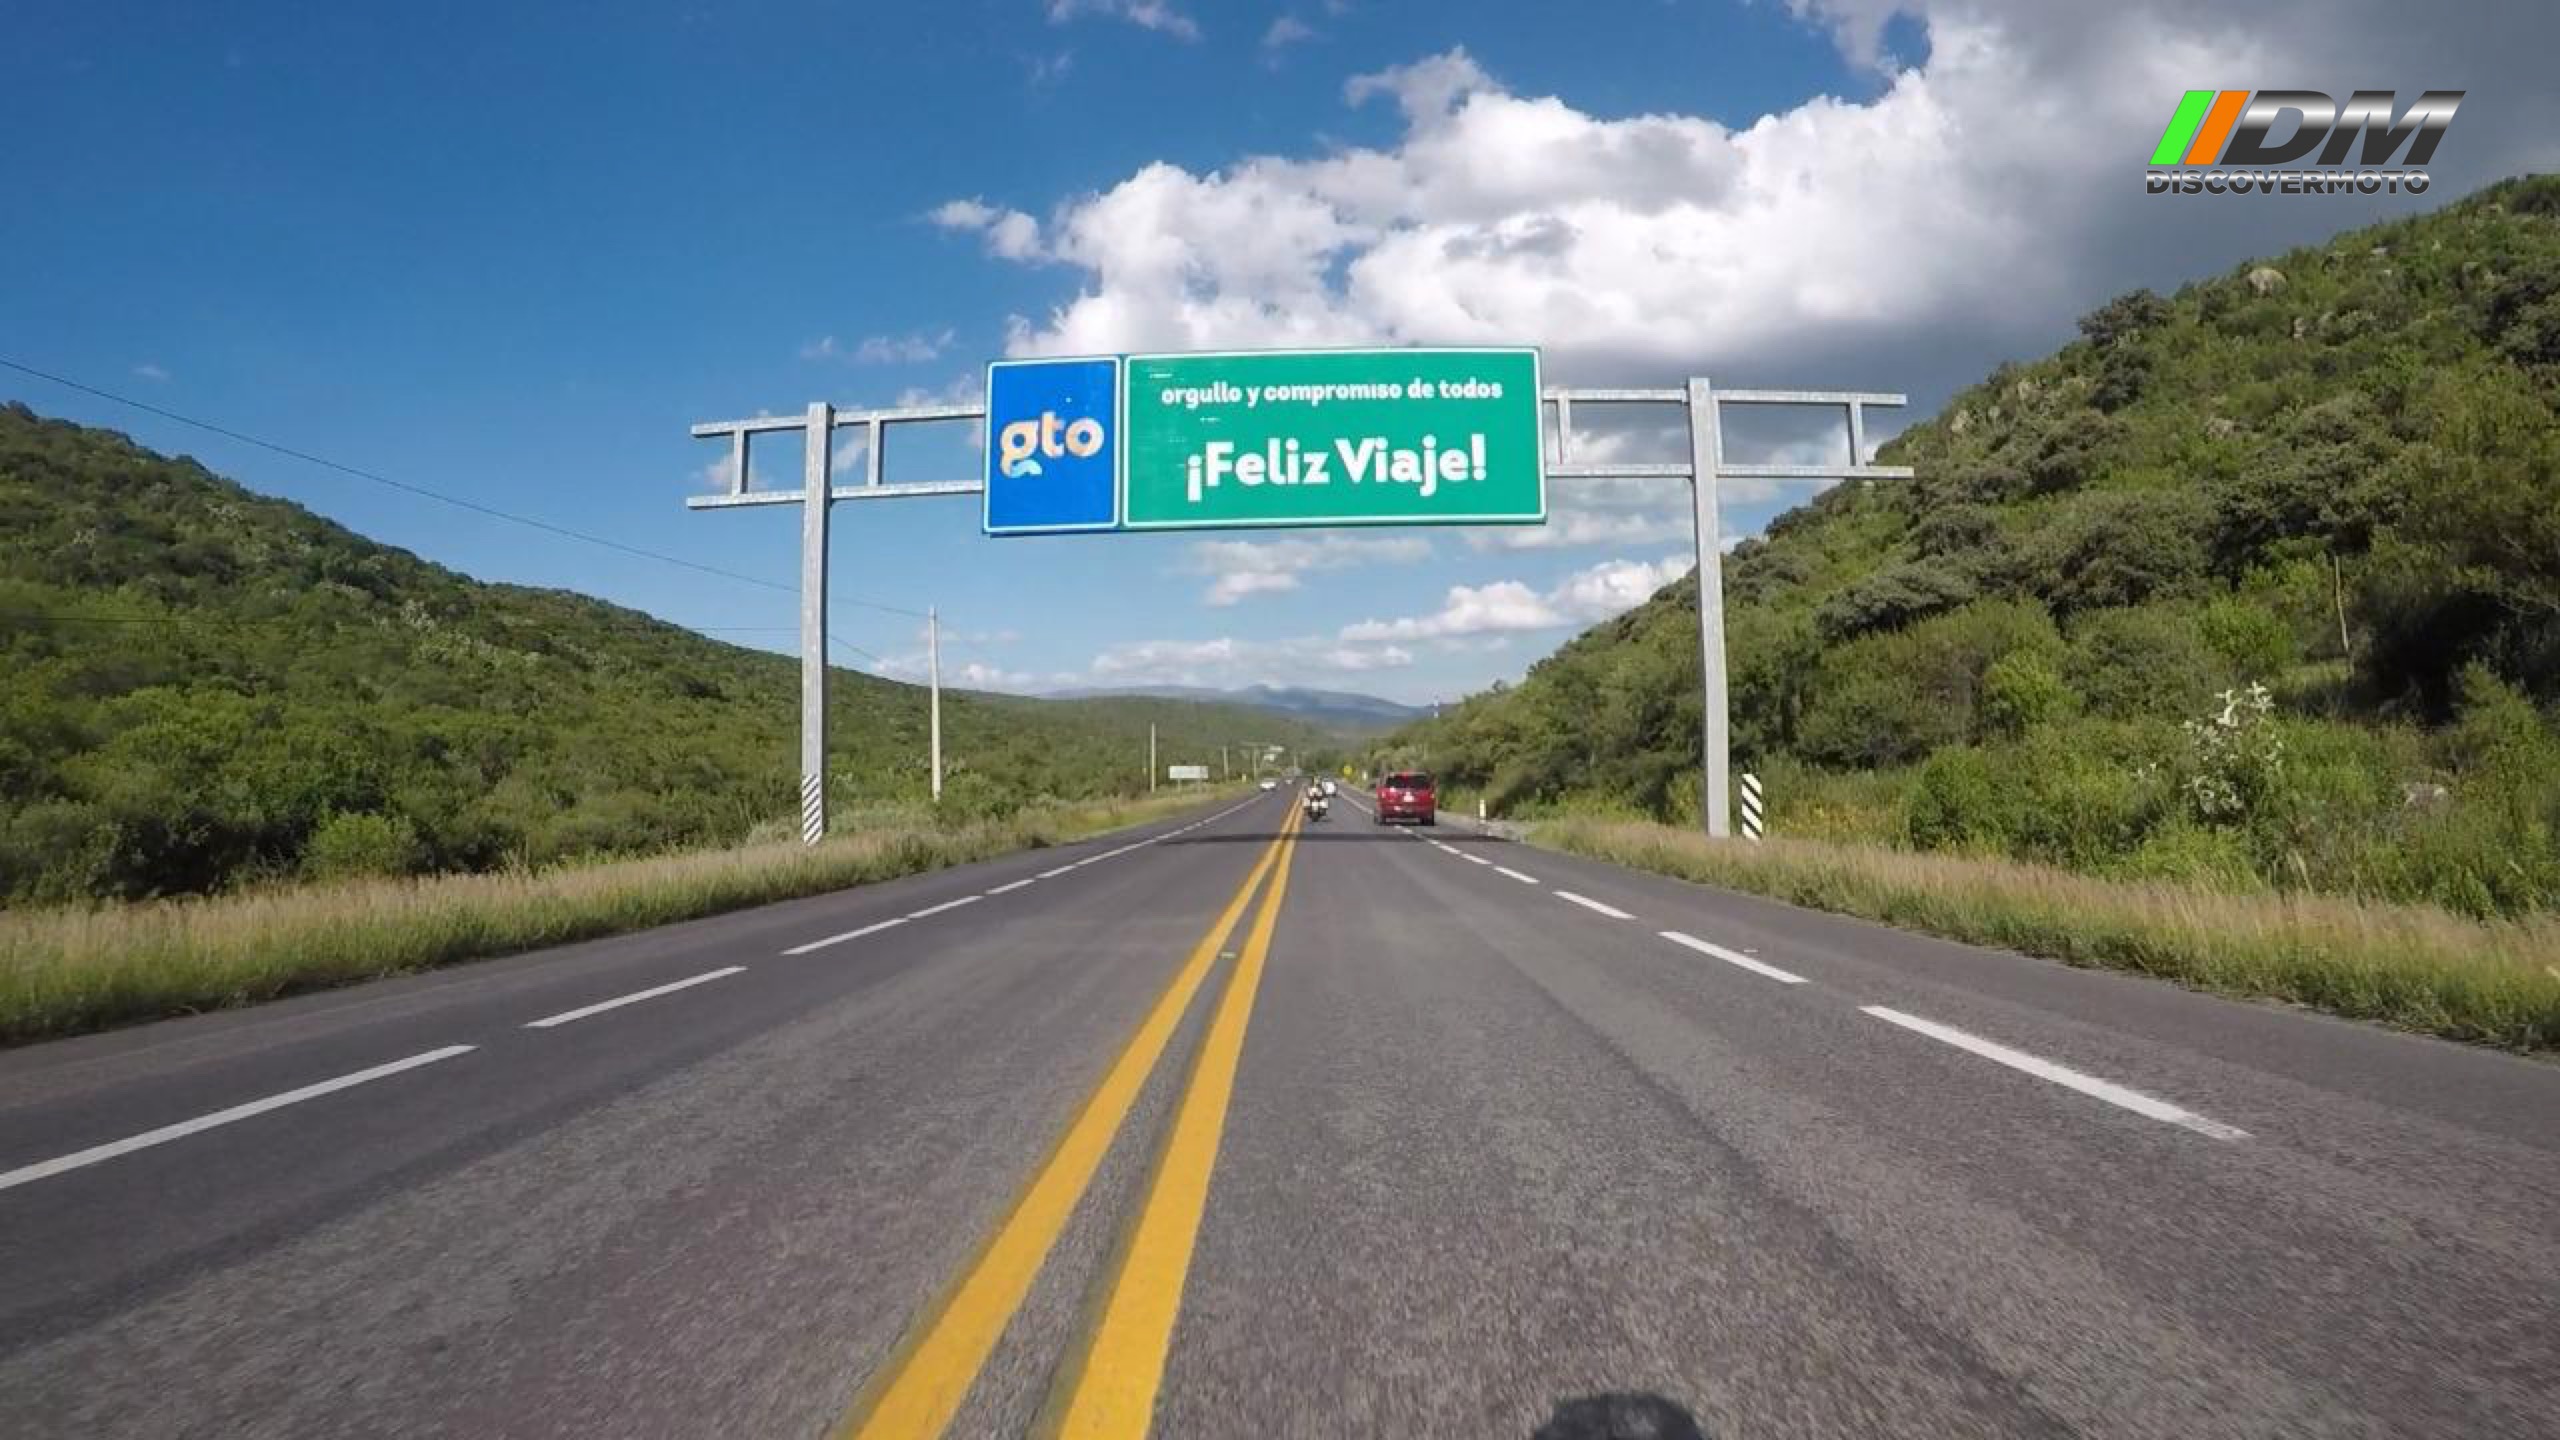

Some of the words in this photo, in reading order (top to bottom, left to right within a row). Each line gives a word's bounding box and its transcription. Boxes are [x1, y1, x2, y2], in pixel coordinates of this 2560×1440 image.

[1161, 380, 1242, 410] orgullo
[1245, 385, 1261, 408] y
[1263, 383, 1403, 407] compromiso
[1407, 376, 1435, 399] de
[1438, 376, 1503, 399] todos
[1000, 411, 1105, 478] gto
[1186, 437, 1331, 502] ¡Feliz
[1333, 433, 1487, 496] Viaje!
